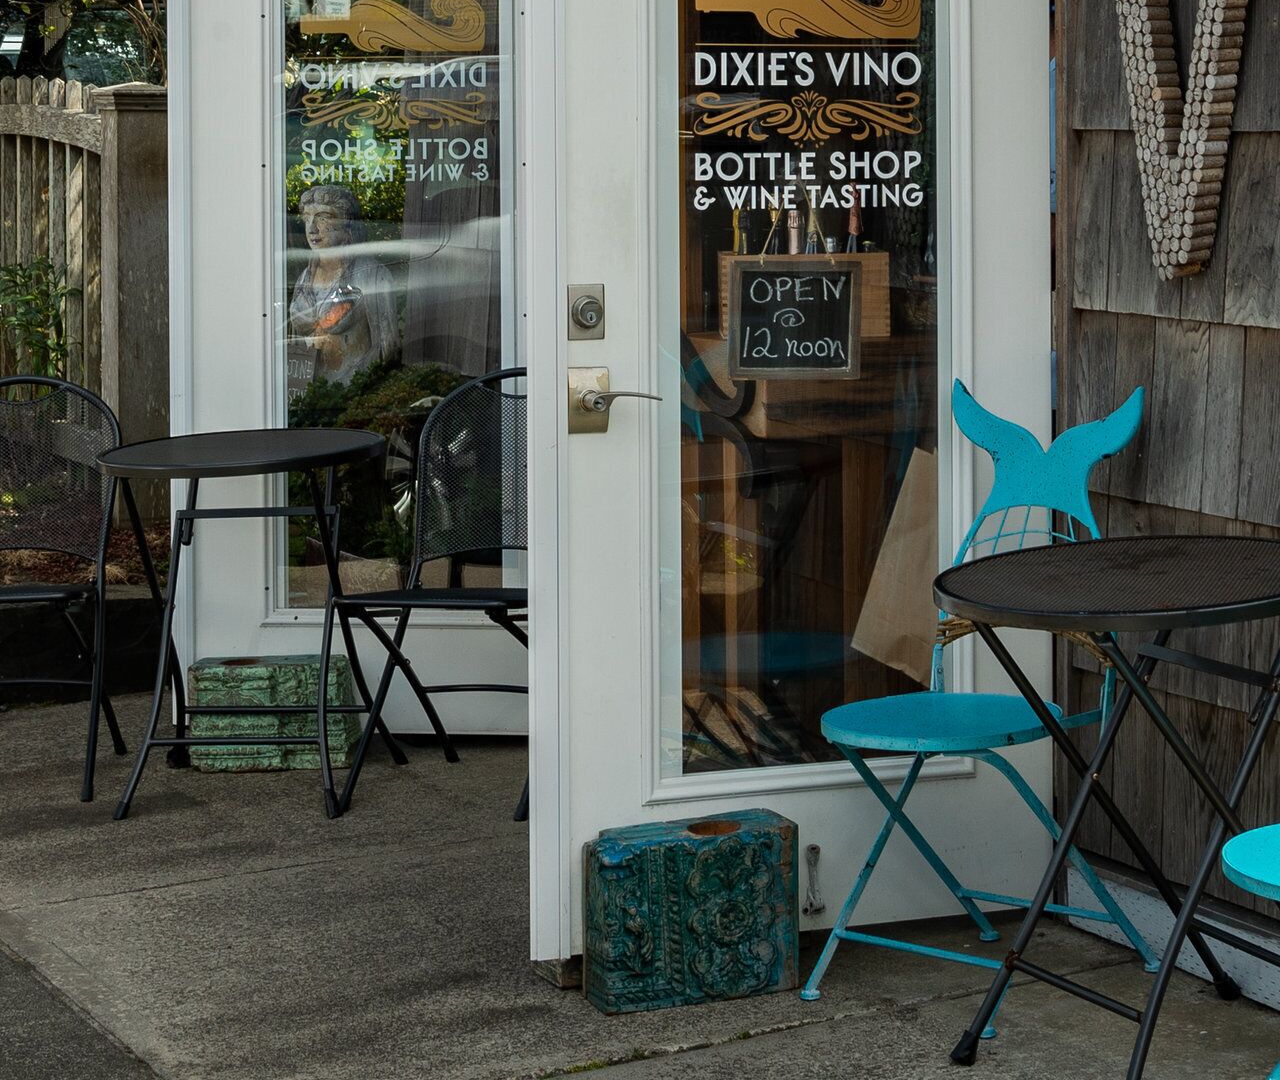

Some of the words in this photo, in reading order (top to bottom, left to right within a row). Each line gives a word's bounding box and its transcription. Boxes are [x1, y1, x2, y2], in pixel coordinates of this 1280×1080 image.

[694, 50, 816, 87] DIXIE'S
[824, 50, 923, 87] VINO
[694, 151, 817, 182] BOTTLE
[828, 150, 922, 181] SHOP
[693, 185, 716, 211] &
[723, 185, 797, 210] WINE
[805, 183, 924, 209] TASTING
[749, 275, 847, 304] OPEN
[773, 307, 806, 328] @
[743, 326, 778, 358] 12
